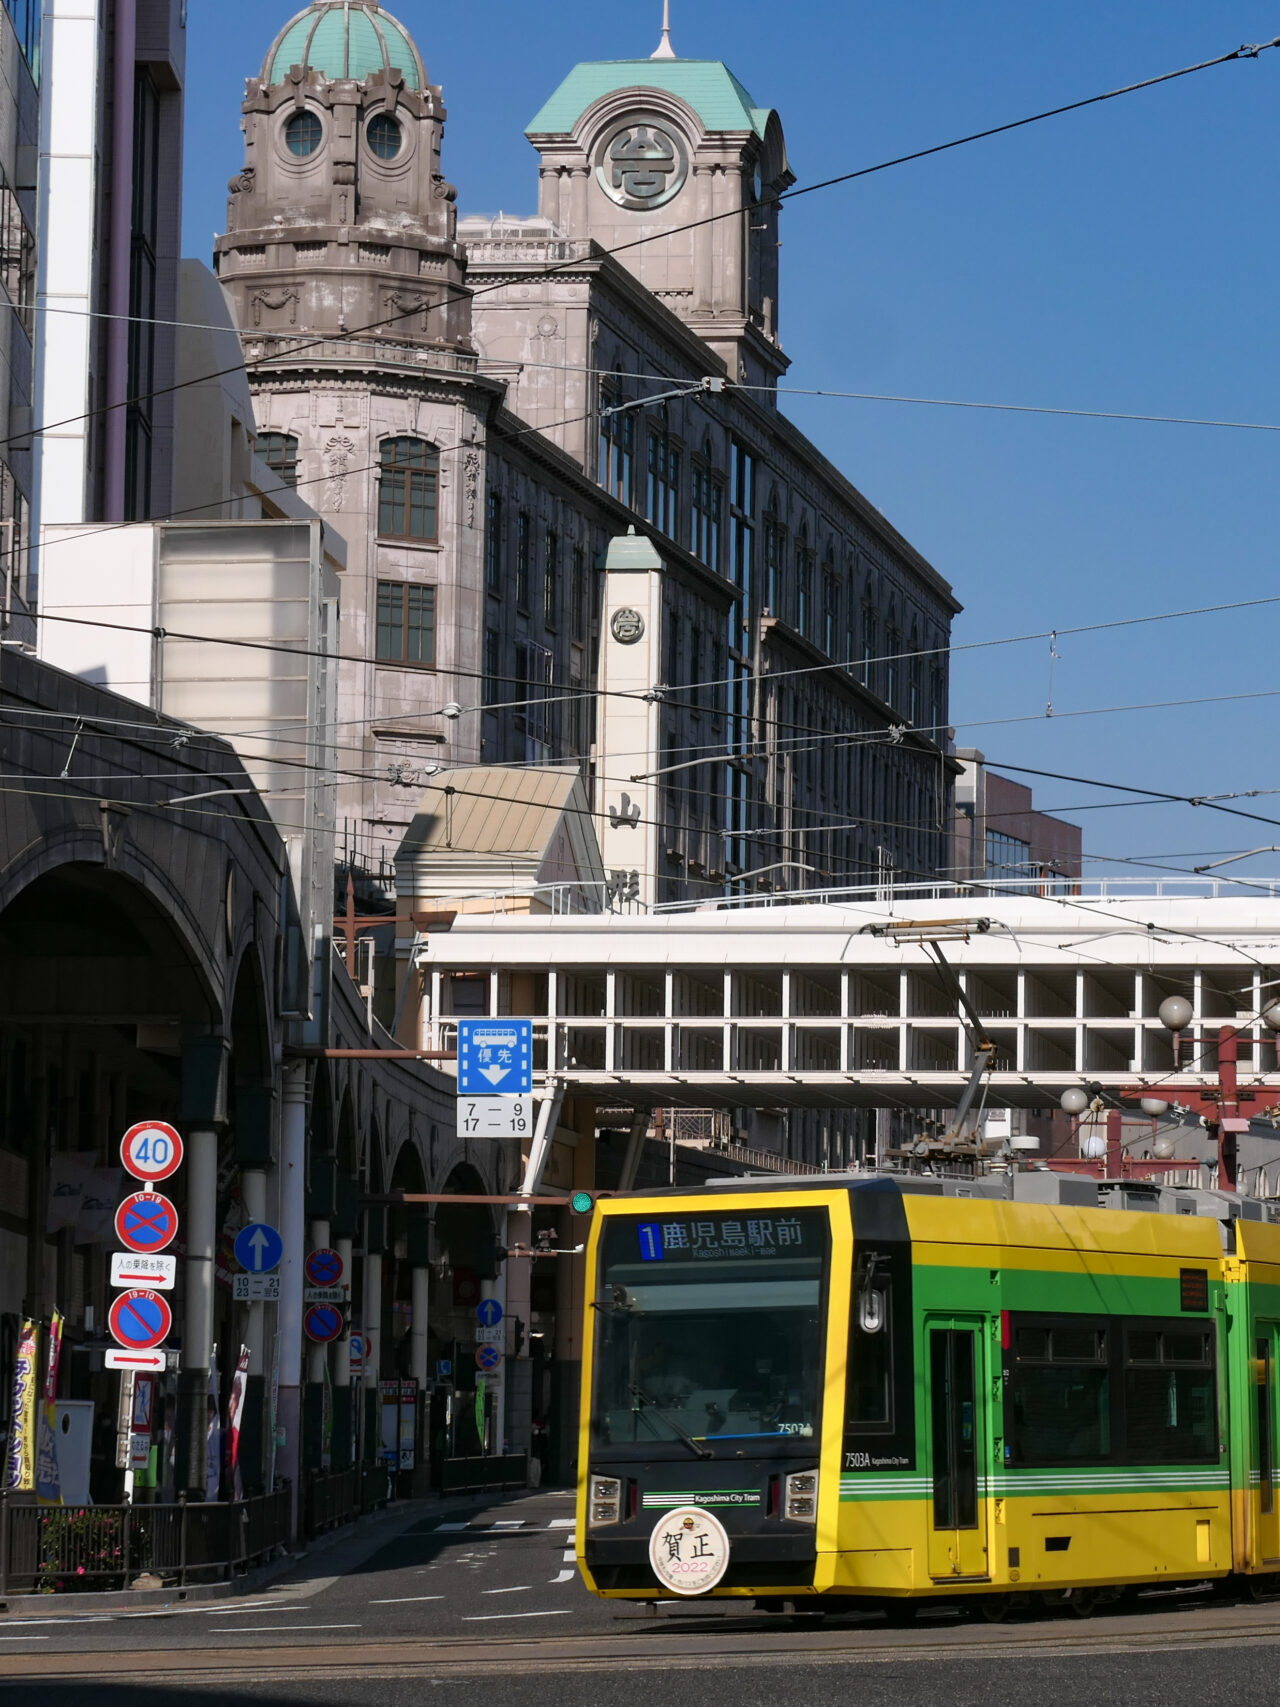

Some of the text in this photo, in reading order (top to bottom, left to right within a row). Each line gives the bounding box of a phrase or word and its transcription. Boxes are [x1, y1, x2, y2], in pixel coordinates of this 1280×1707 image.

[477, 1048, 512, 1064] 優先
[467, 1103, 476, 1116] 7
[513, 1103, 523, 1117] 9
[463, 1118, 480, 1131] 17
[510, 1118, 526, 1132] 19
[135, 1137, 168, 1164] 40
[663, 1217, 802, 1249] 鹿児島駅前
[641, 1226, 656, 1258] 1
[117, 1259, 171, 1271] 人の乗降を除く
[236, 1278, 249, 1288] 10
[269, 1278, 280, 1288] 21
[236, 1287, 249, 1298] 23
[846, 1453, 871, 1467] 7503A
[695, 1493, 760, 1505] Kagoshima City Tram
[671, 1562, 709, 1573] 2022
